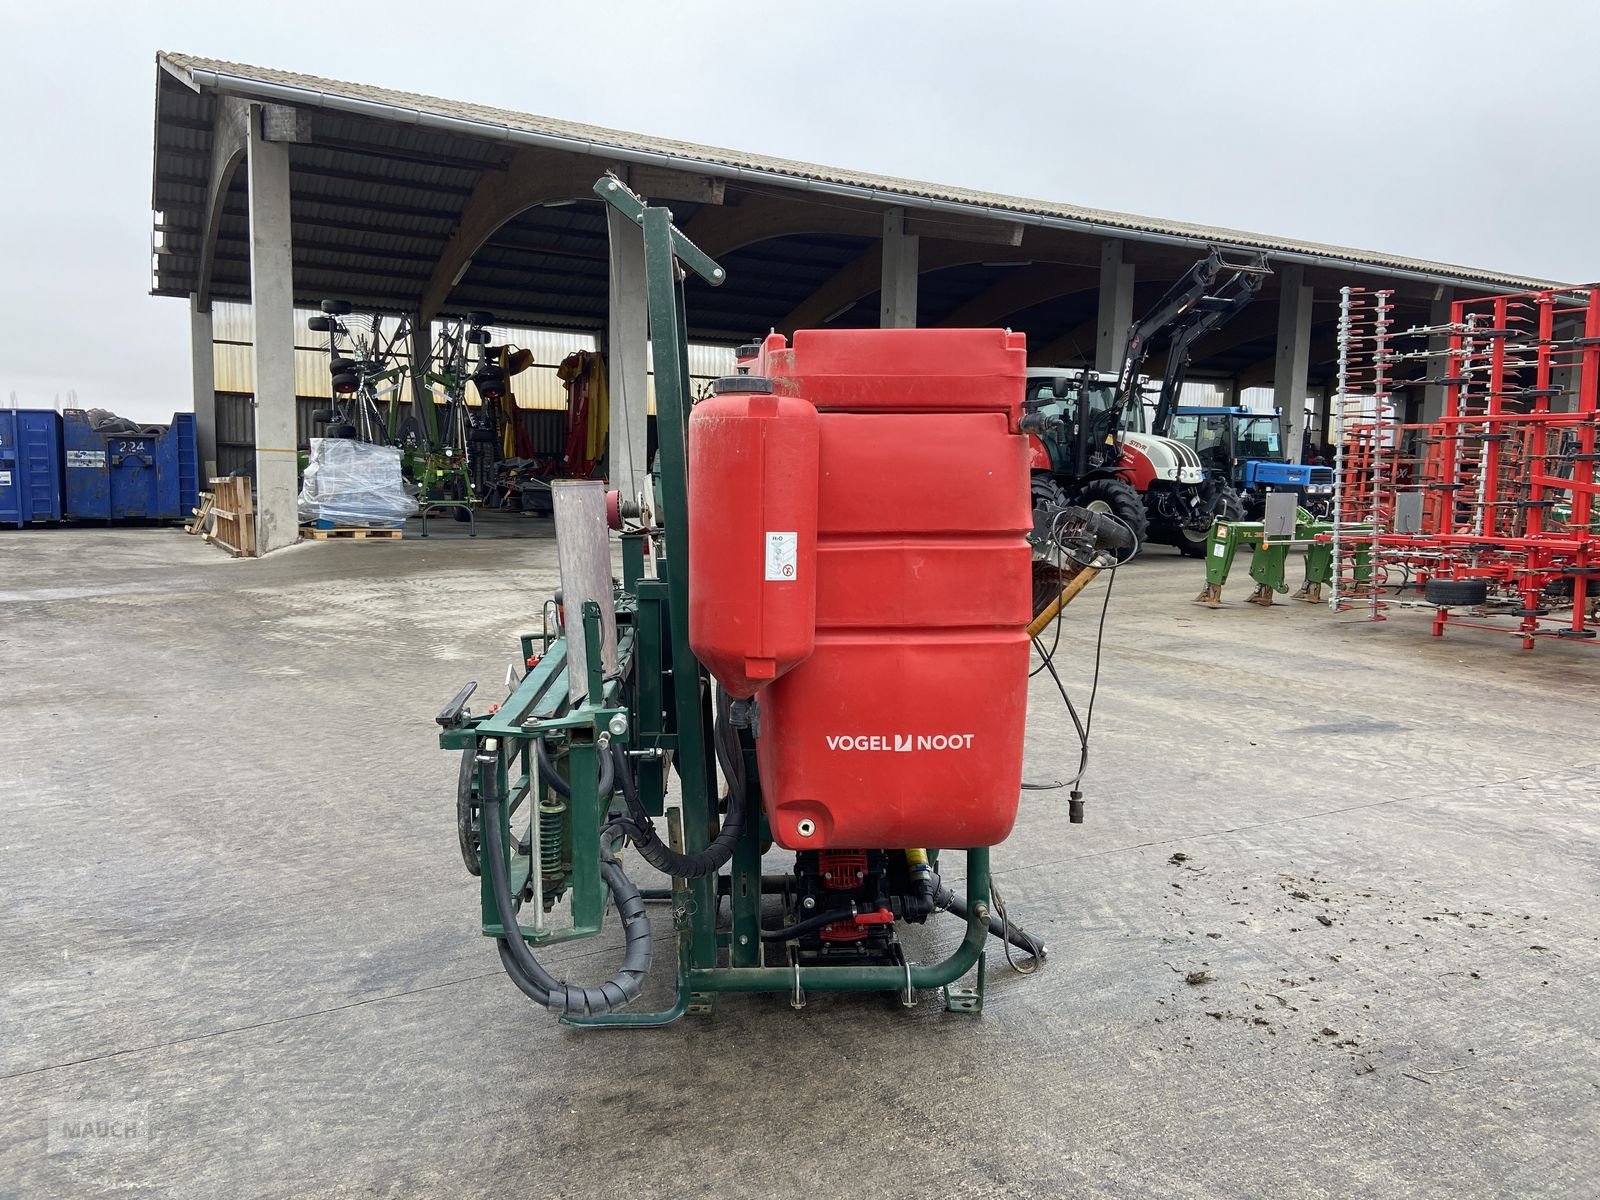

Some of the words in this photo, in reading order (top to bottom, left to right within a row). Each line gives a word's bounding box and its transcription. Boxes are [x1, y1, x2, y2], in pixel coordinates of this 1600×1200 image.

[1120, 358, 1131, 392] STEYR
[119, 441, 145, 453] 224
[1129, 440, 1148, 451] STEYR
[825, 735, 891, 751] VOGEL
[917, 734, 975, 750] NOOT
